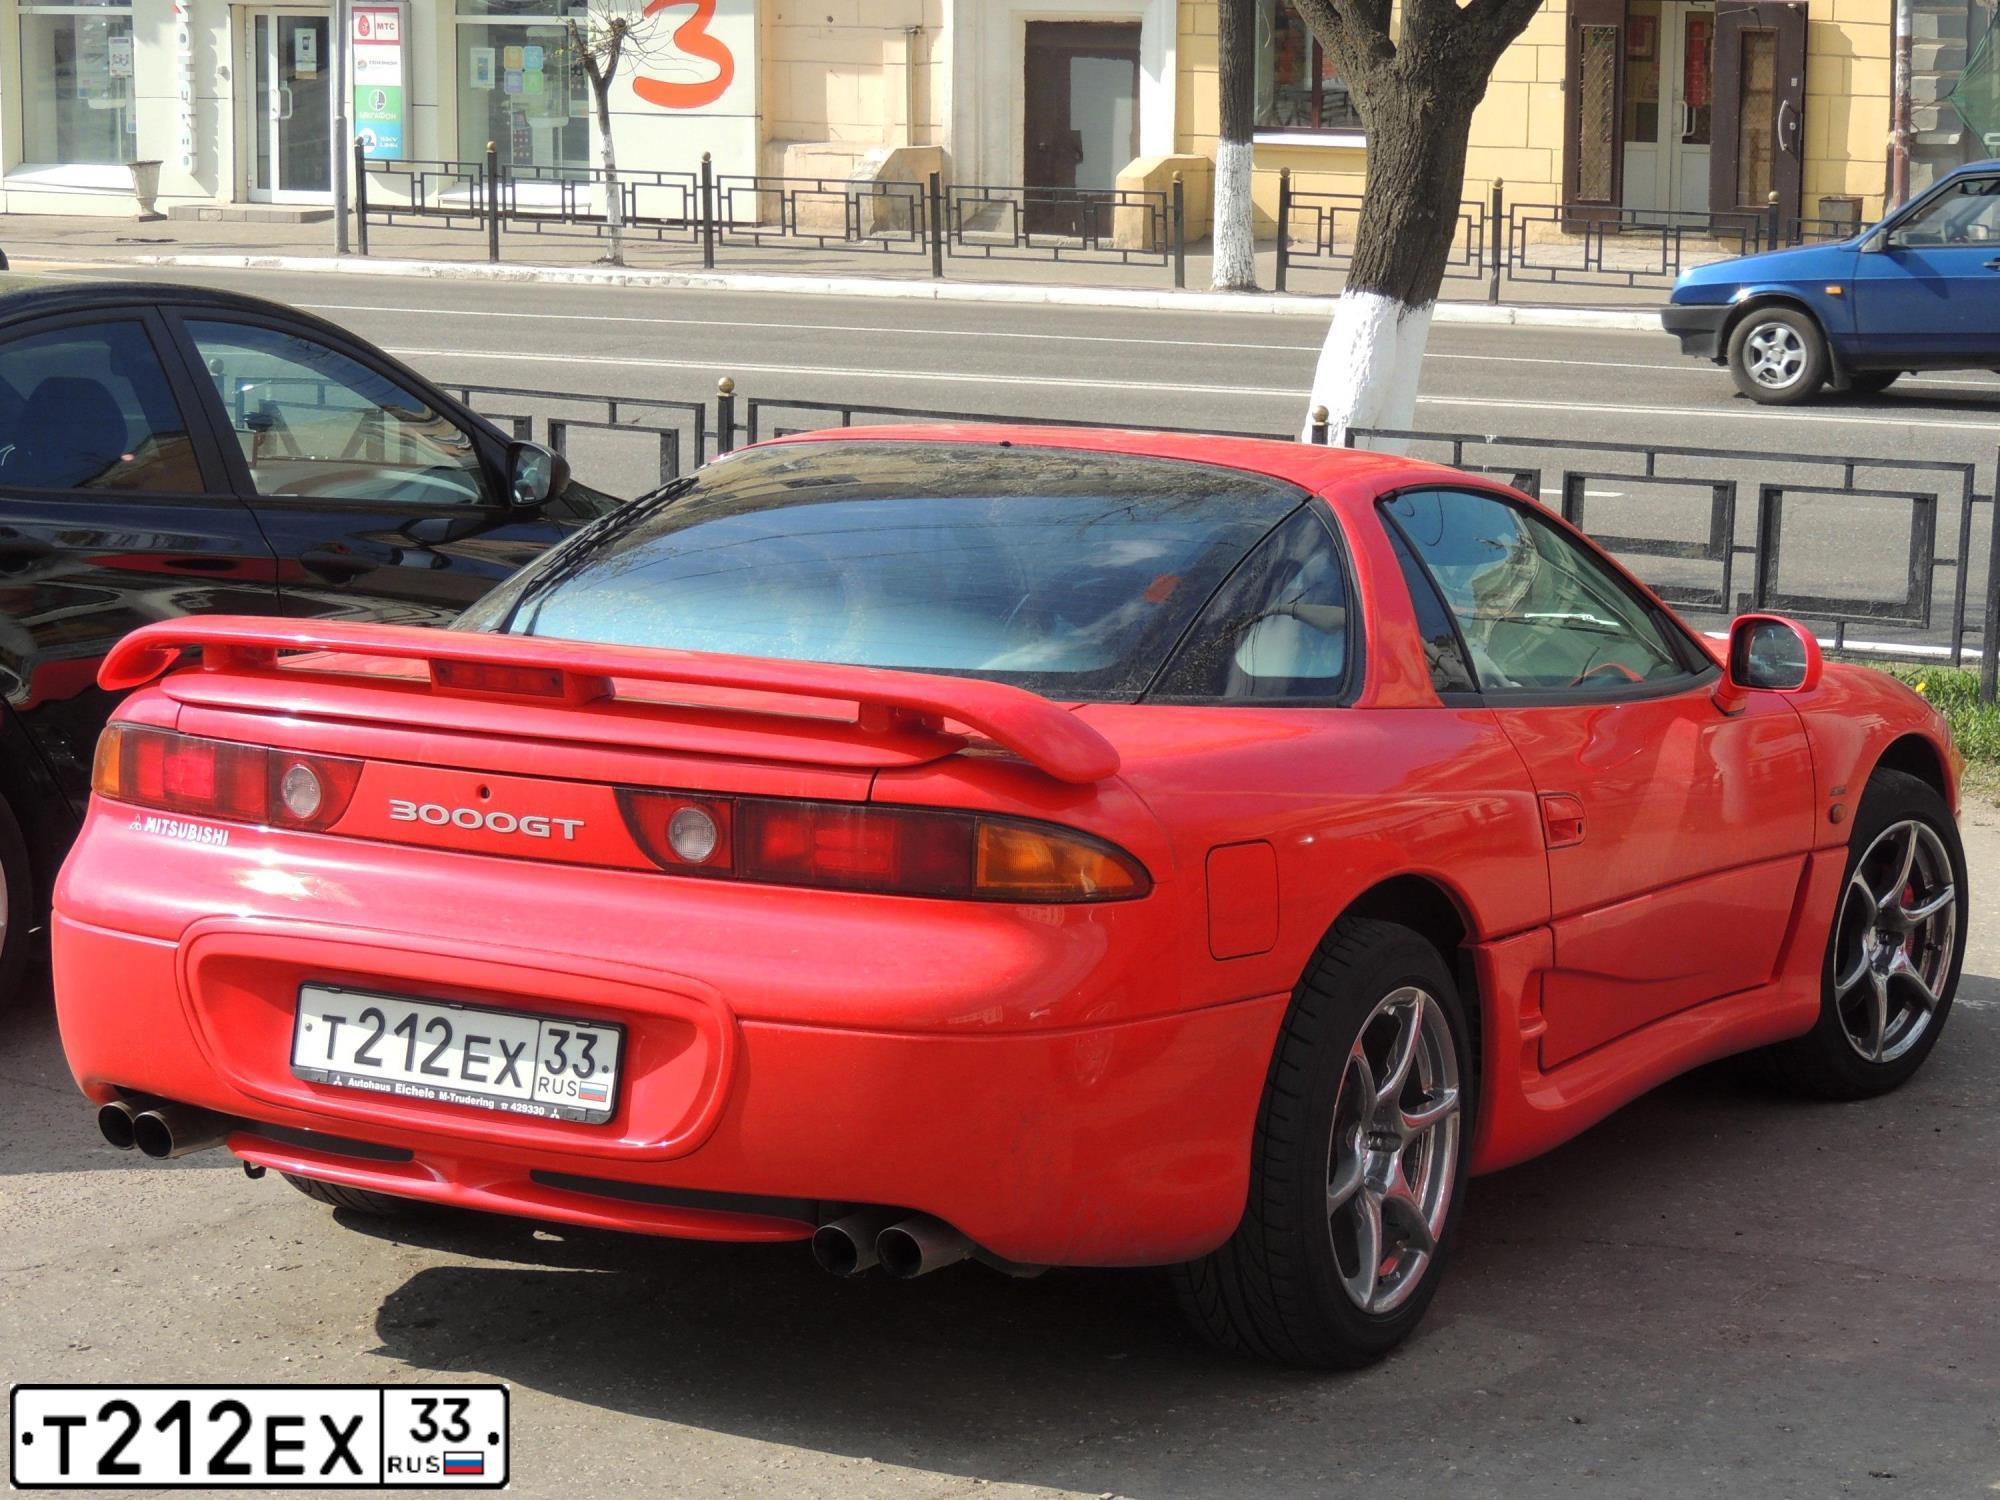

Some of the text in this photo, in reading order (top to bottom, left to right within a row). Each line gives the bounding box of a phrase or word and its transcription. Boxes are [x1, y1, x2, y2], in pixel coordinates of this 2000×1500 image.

[144, 816, 230, 847] MITSUBISHI
[389, 799, 584, 840] 3000GT
[544, 1029, 599, 1079] 33
[347, 1078, 391, 1093] Autohaus
[395, 1083, 435, 1100] Eichele
[510, 1103, 545, 1117] 429330
[537, 1076, 577, 1097] RUS
